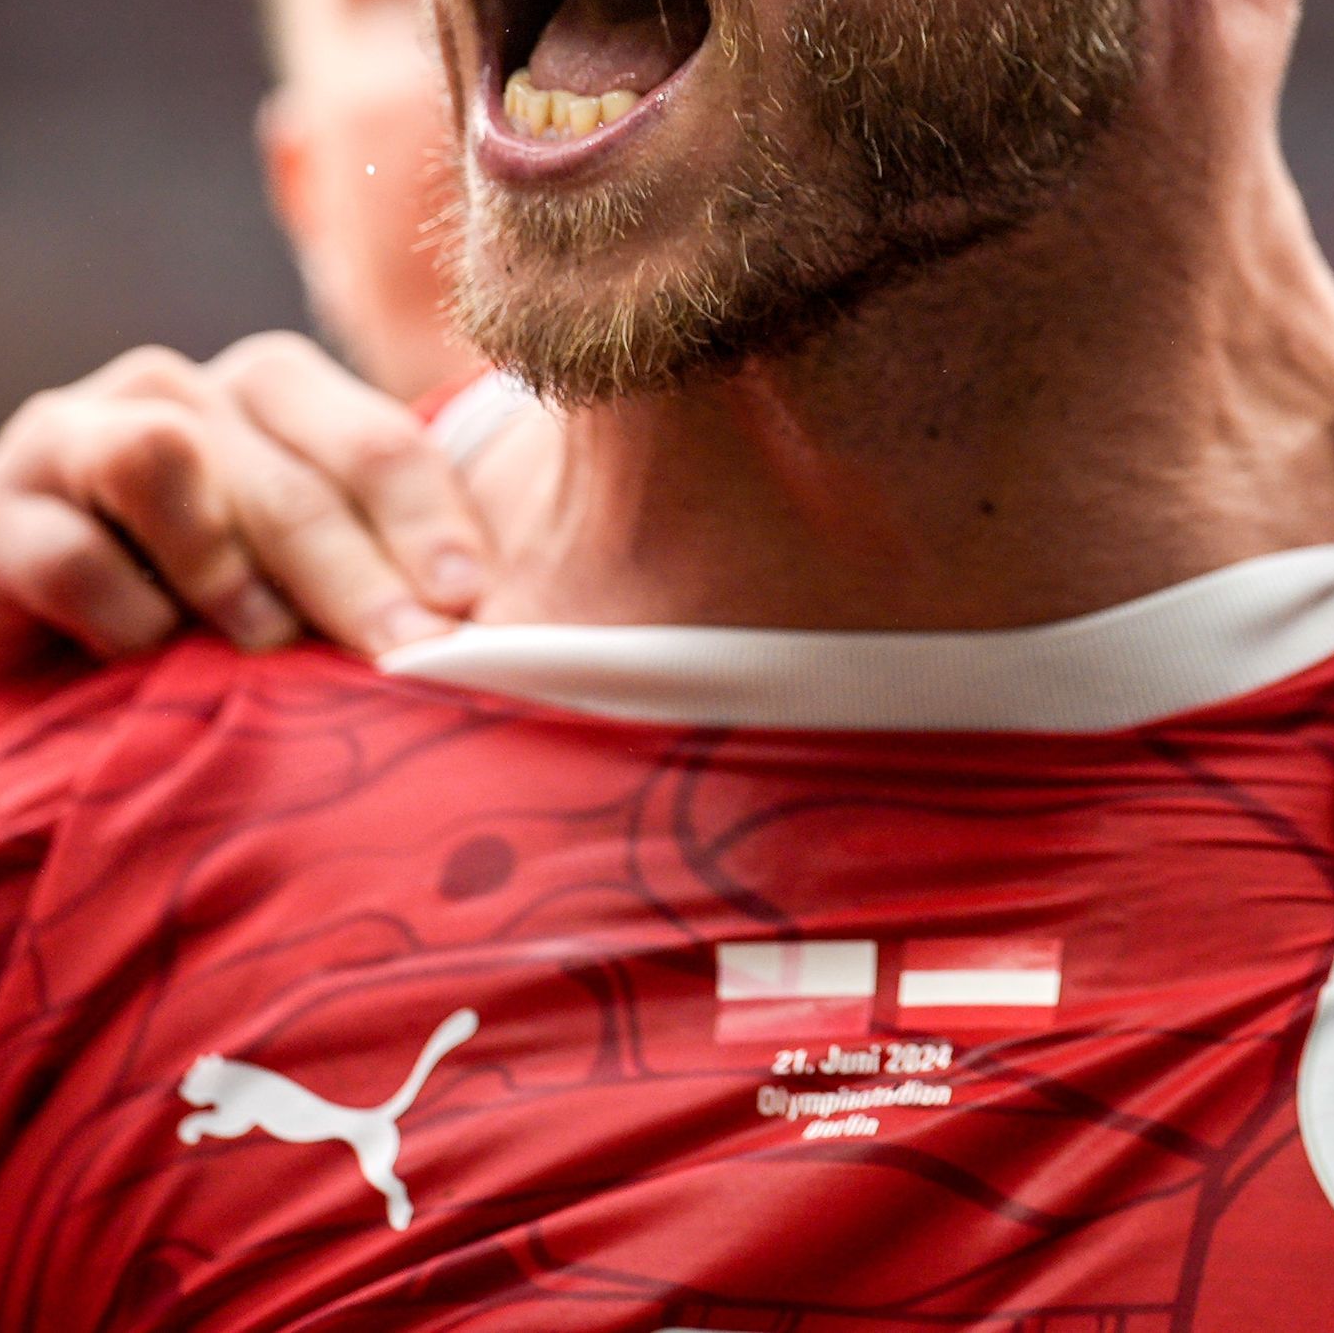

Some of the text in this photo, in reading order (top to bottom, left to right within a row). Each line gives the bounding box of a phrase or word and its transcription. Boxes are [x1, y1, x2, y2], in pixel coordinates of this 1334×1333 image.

[771, 1042, 953, 1075] 21. Juni 2024
